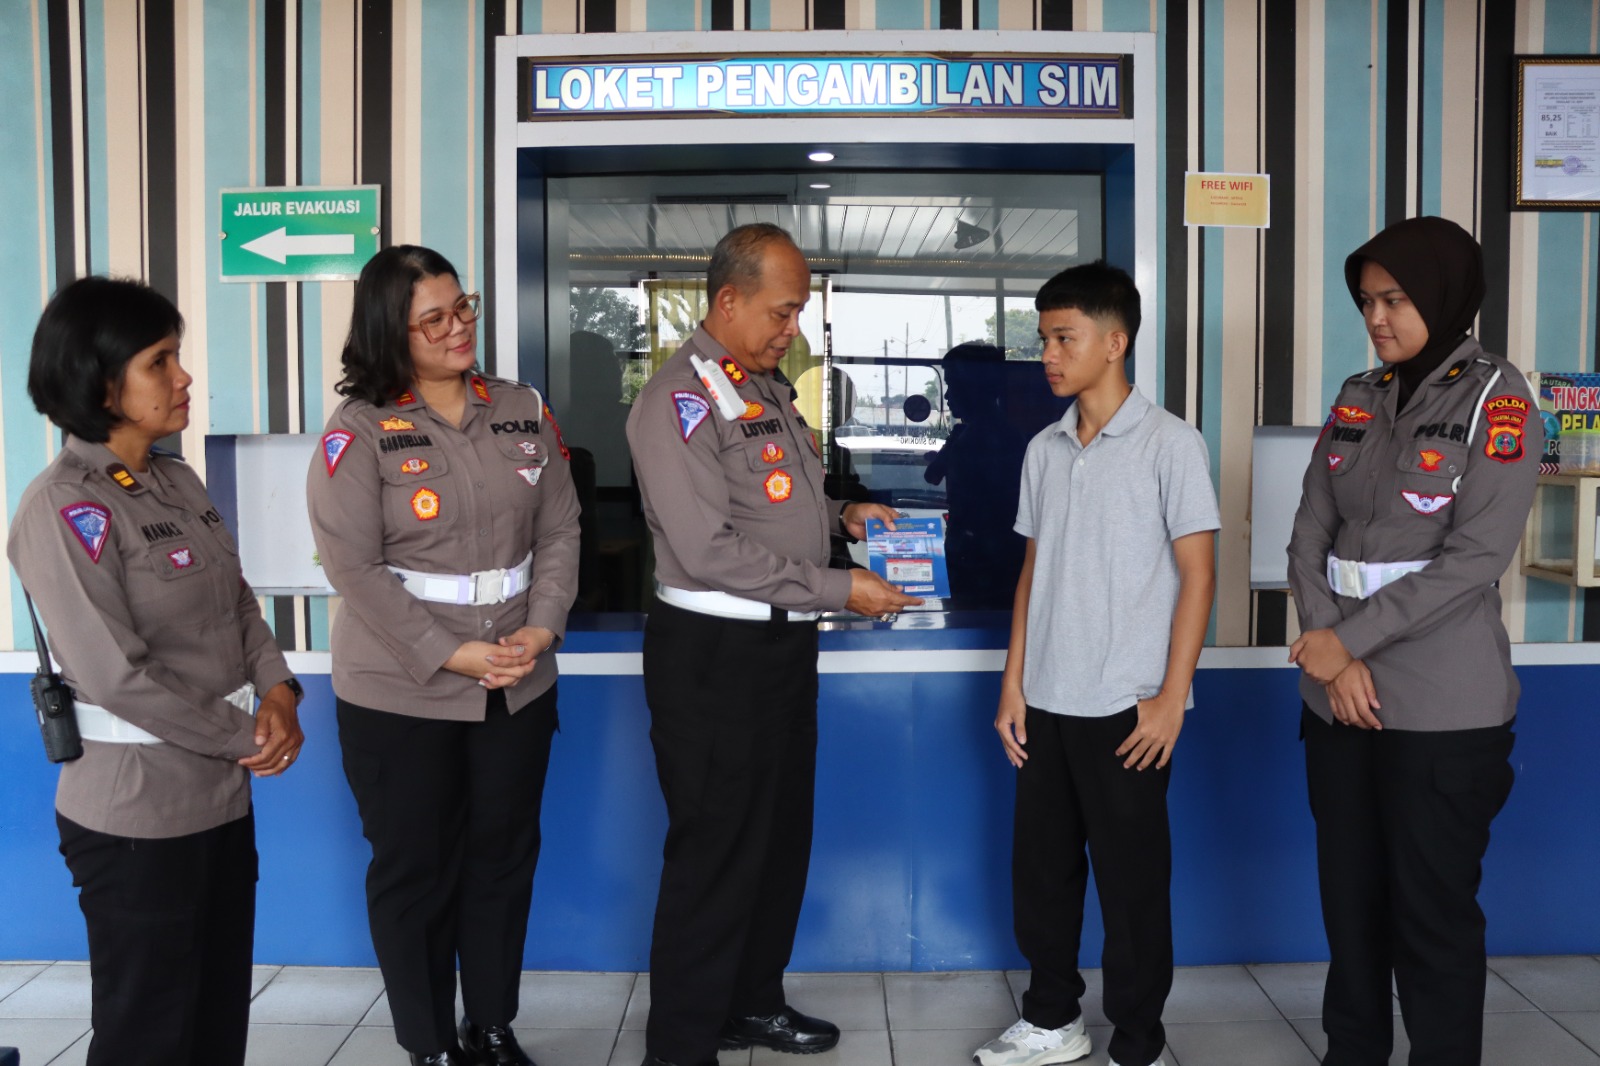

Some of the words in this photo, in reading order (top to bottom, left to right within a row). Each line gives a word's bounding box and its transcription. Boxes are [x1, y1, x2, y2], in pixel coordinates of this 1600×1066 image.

[535, 66, 683, 111] LOKET
[697, 63, 1024, 108] PENGAMBILAN
[1037, 64, 1118, 107] SIM
[1541, 114, 1562, 122] 85,25
[1201, 180, 1226, 190] FREE
[1229, 181, 1253, 191] WIFI
[234, 201, 282, 216] JALUR
[286, 200, 360, 215] EVAKUASI
[1487, 398, 1526, 411] POLDA
[490, 419, 540, 435] POLRI
[740, 418, 783, 439] LUTHFI
